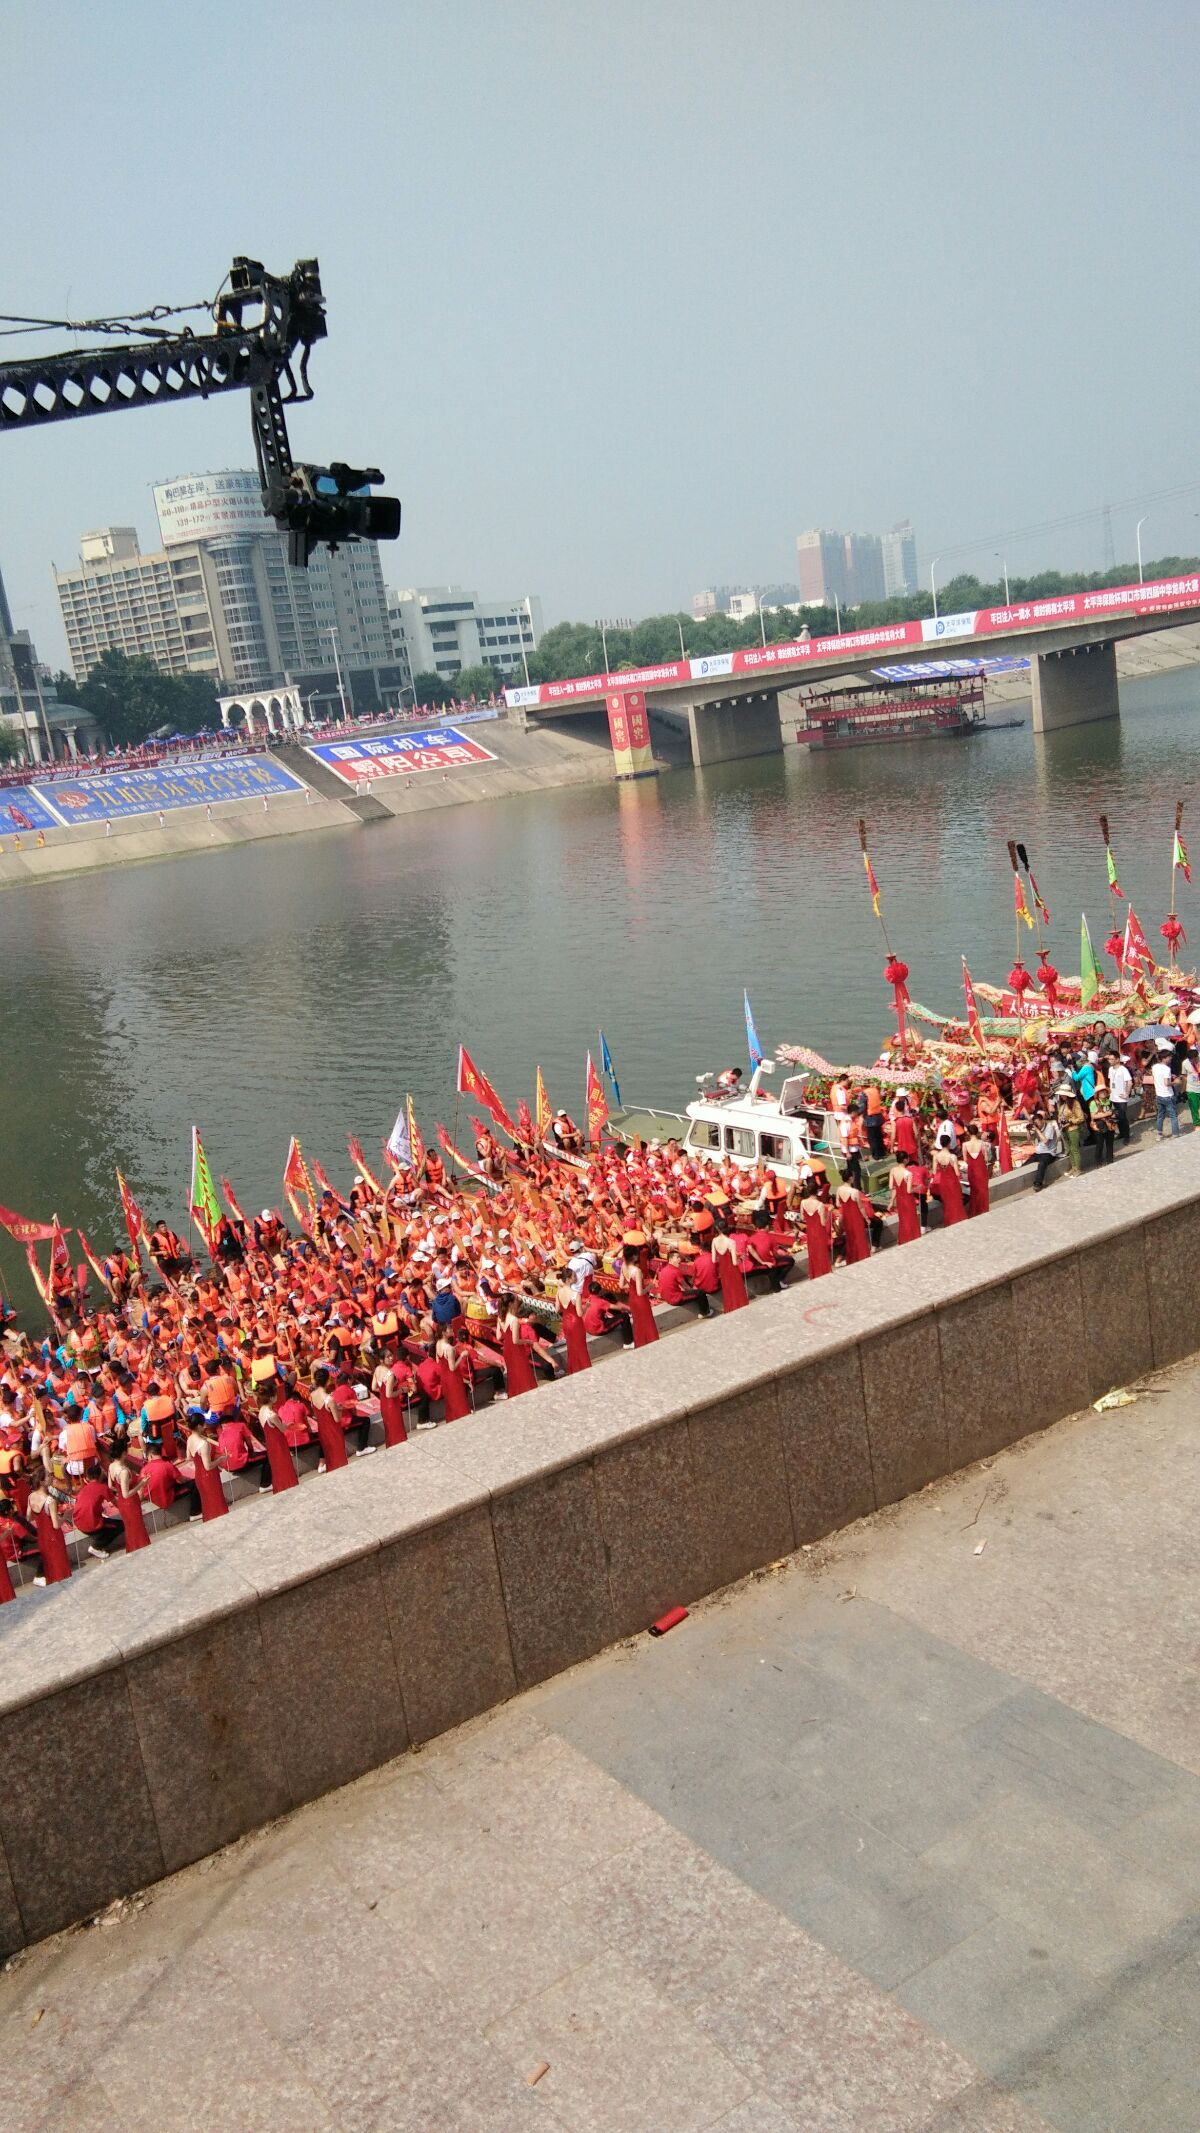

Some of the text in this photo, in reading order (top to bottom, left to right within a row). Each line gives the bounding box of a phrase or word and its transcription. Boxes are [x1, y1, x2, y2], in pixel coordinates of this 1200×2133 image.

[329, 732, 452, 760] 国际机车
[348, 745, 474, 774] 朝阳公司
